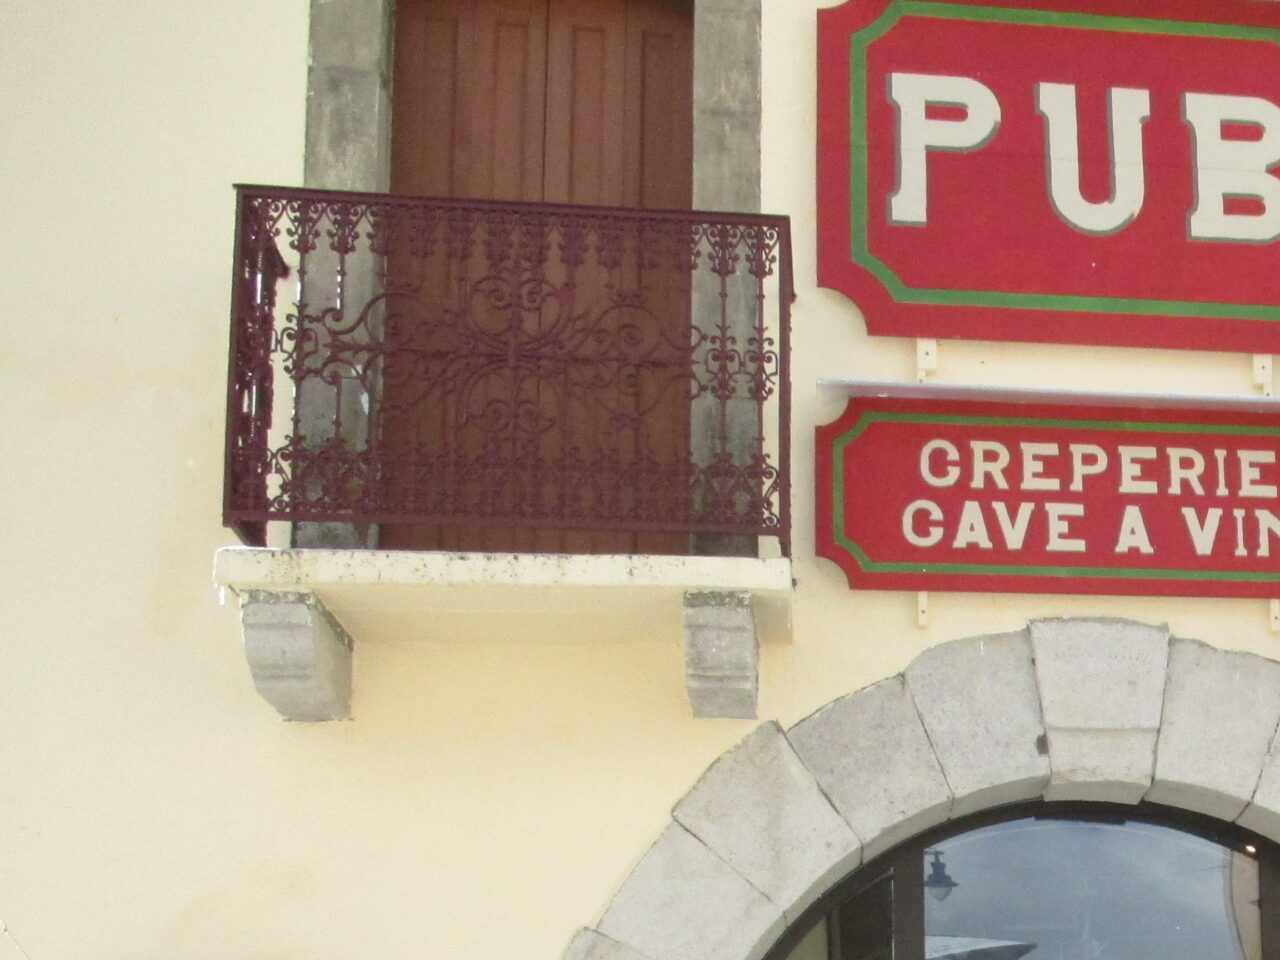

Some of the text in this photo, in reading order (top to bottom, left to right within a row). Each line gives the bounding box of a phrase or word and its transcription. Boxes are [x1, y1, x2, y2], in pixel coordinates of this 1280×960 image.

[919, 439, 1278, 498] CREPERIE
[902, 499, 1086, 553] CAVE
[1114, 505, 1154, 554] A
